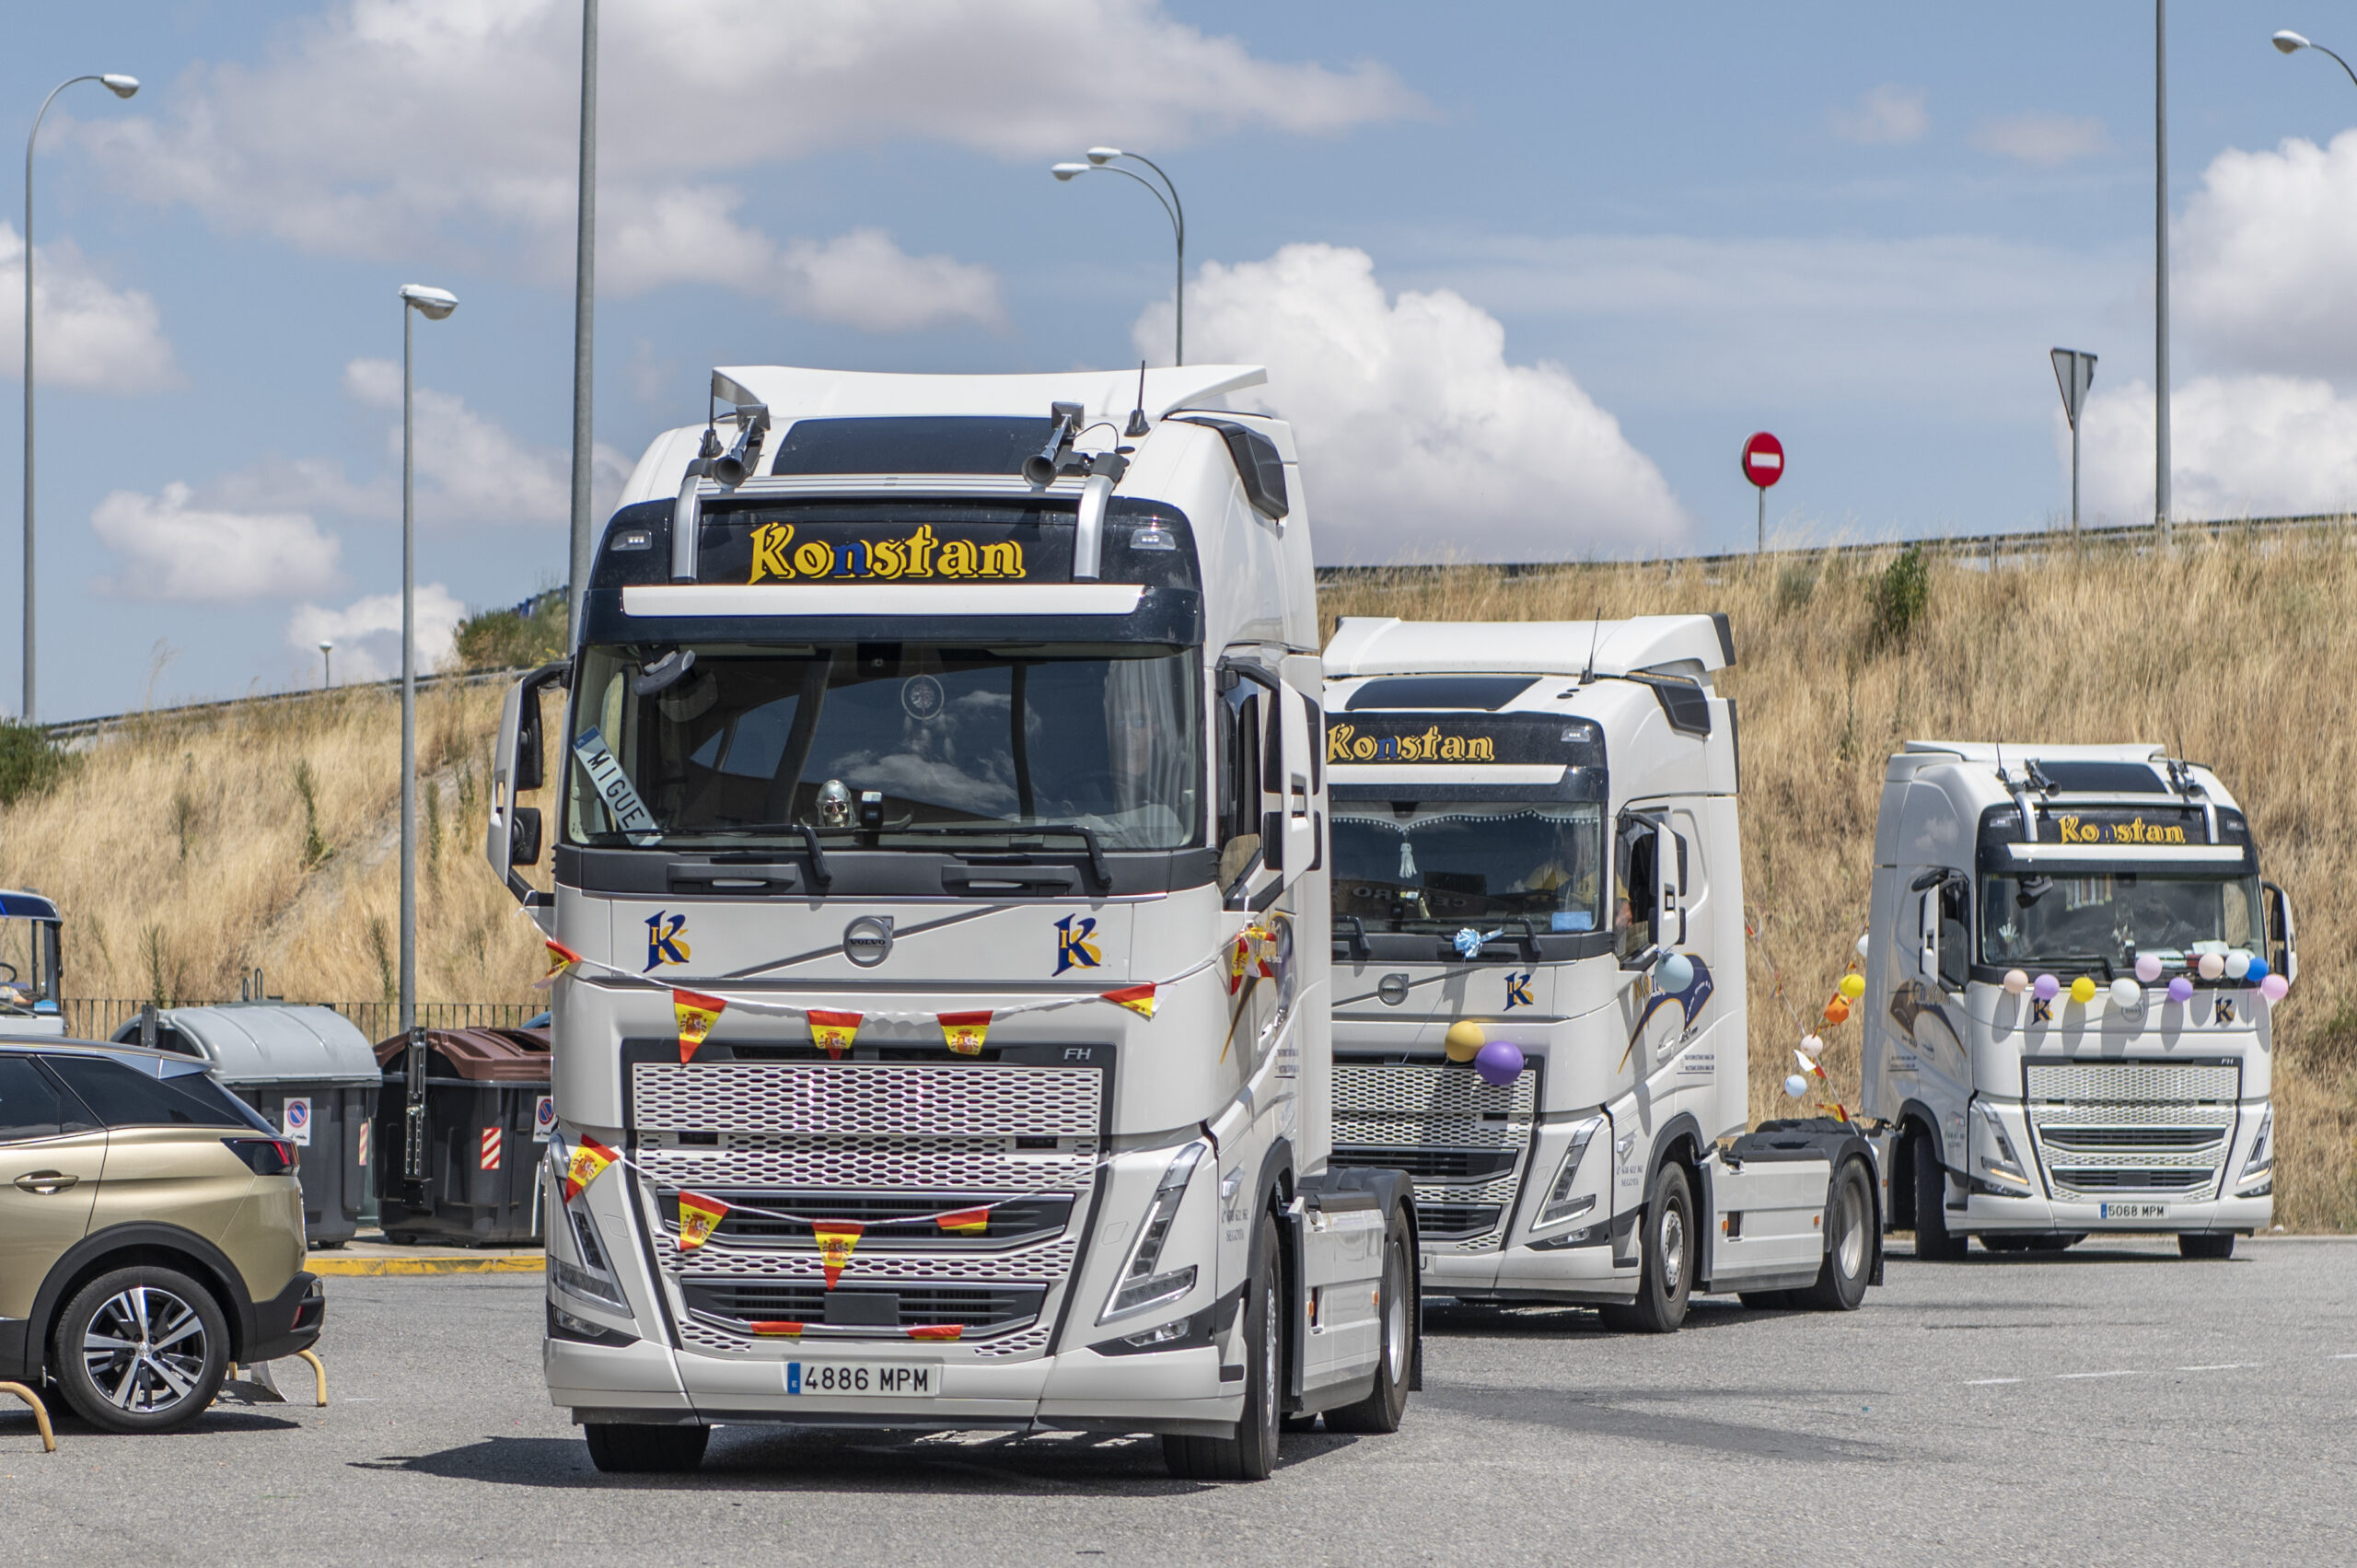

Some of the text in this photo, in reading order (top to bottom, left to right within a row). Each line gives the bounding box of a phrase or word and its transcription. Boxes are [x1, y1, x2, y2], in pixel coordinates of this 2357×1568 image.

[747, 522, 1027, 586] Konstan
[1326, 723, 1495, 764] Konstan
[2058, 815, 2186, 844] Konstan
[1063, 1048, 1092, 1061] FH
[2142, 1205, 2165, 1217] MPM
[805, 1366, 928, 1391] 4886 MPM
